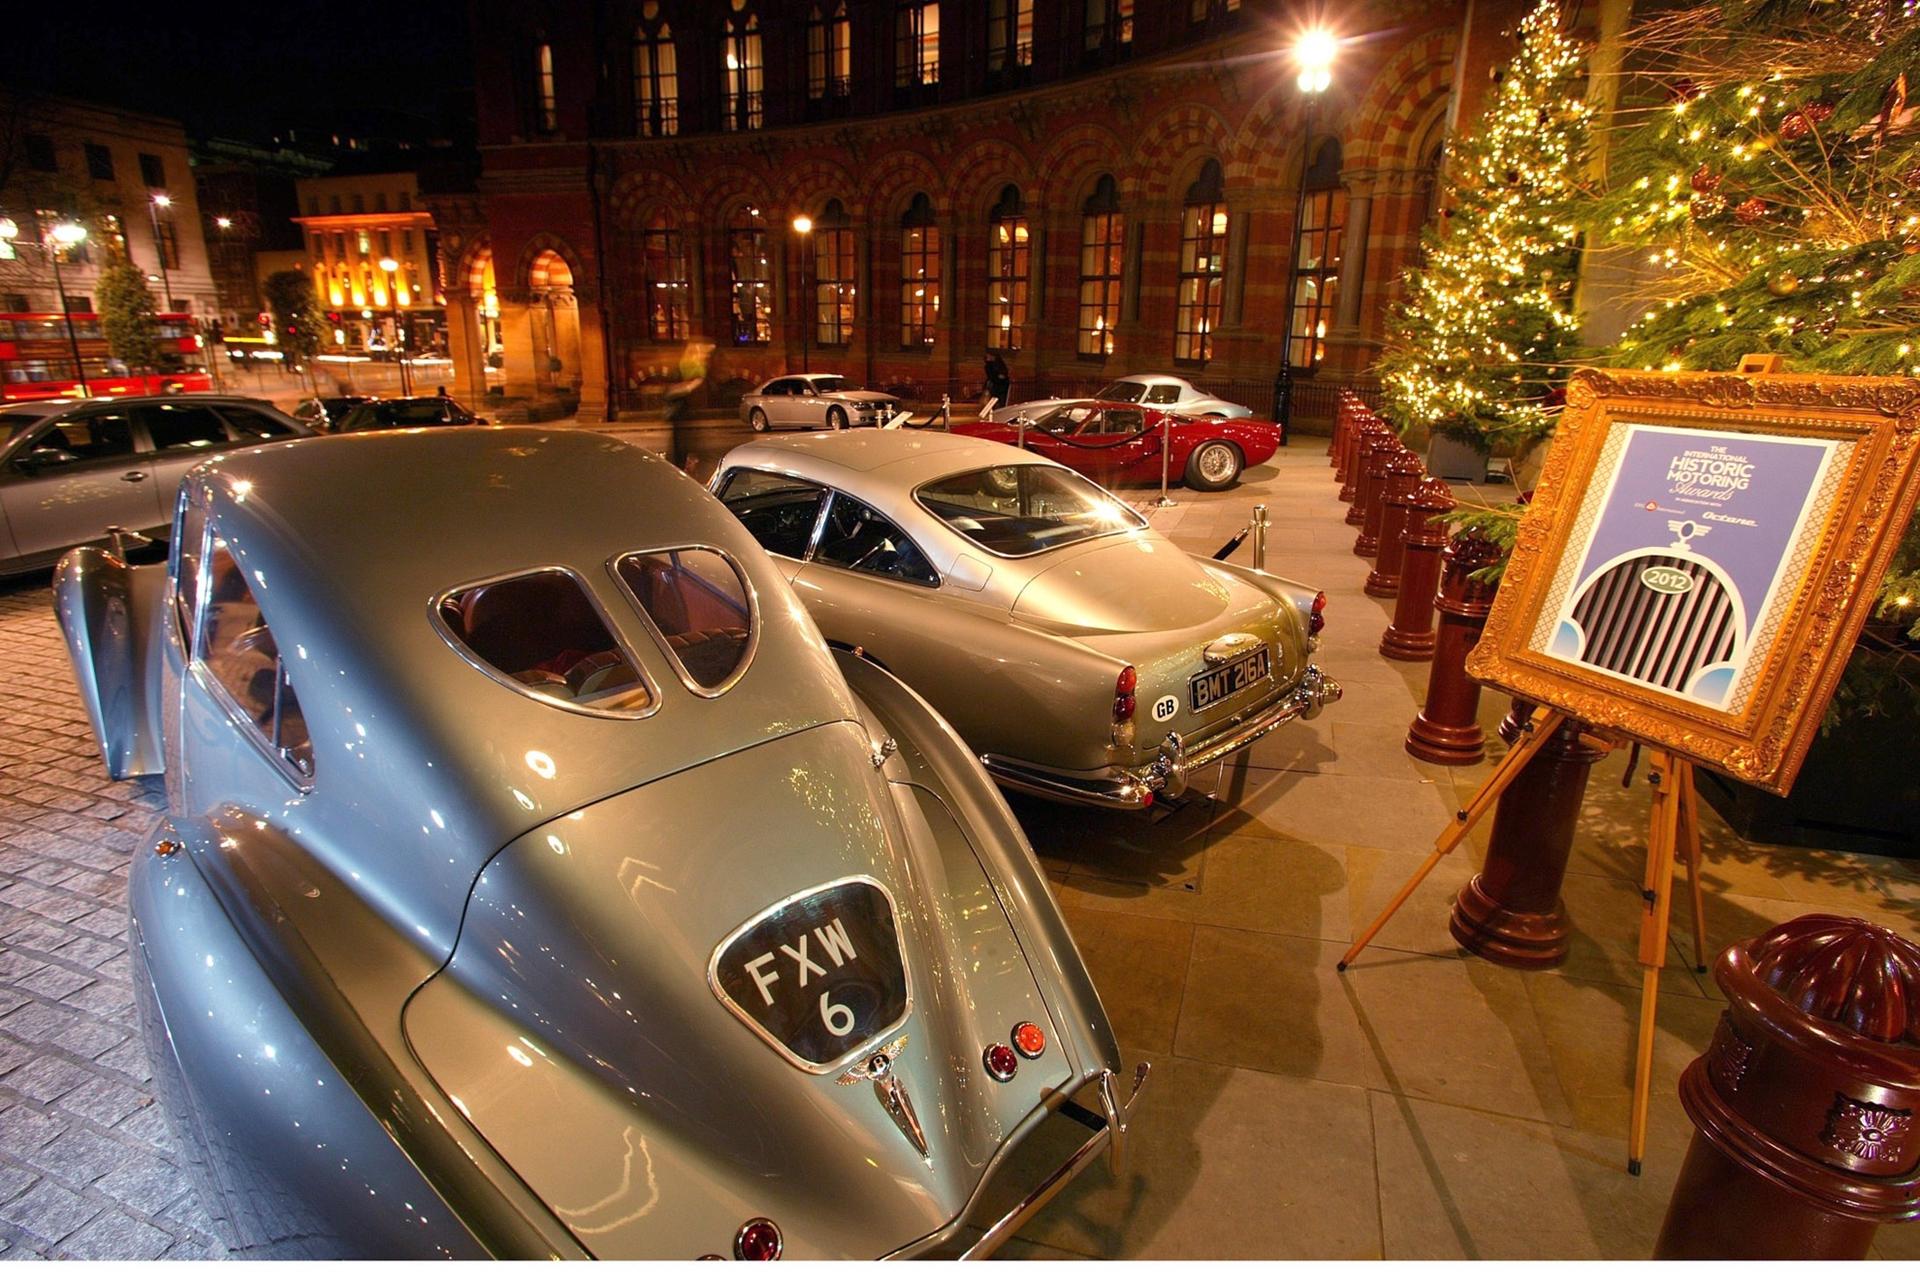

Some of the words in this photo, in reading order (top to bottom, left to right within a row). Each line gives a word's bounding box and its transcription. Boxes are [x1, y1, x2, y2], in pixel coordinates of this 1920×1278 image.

[1683, 450, 1748, 463] INTERNATIONAL
[1711, 446, 1728, 454] THE
[1670, 456, 1755, 477] HISTORIC
[1667, 470, 1750, 490] MOTORING
[1668, 482, 1735, 500] Awards
[1648, 571, 1687, 589] 2012
[1196, 668, 1230, 706] BMT
[1234, 653, 1266, 690] 216A
[1157, 699, 1175, 718] GB
[743, 917, 857, 1007] FXW
[820, 991, 855, 1037] 6
